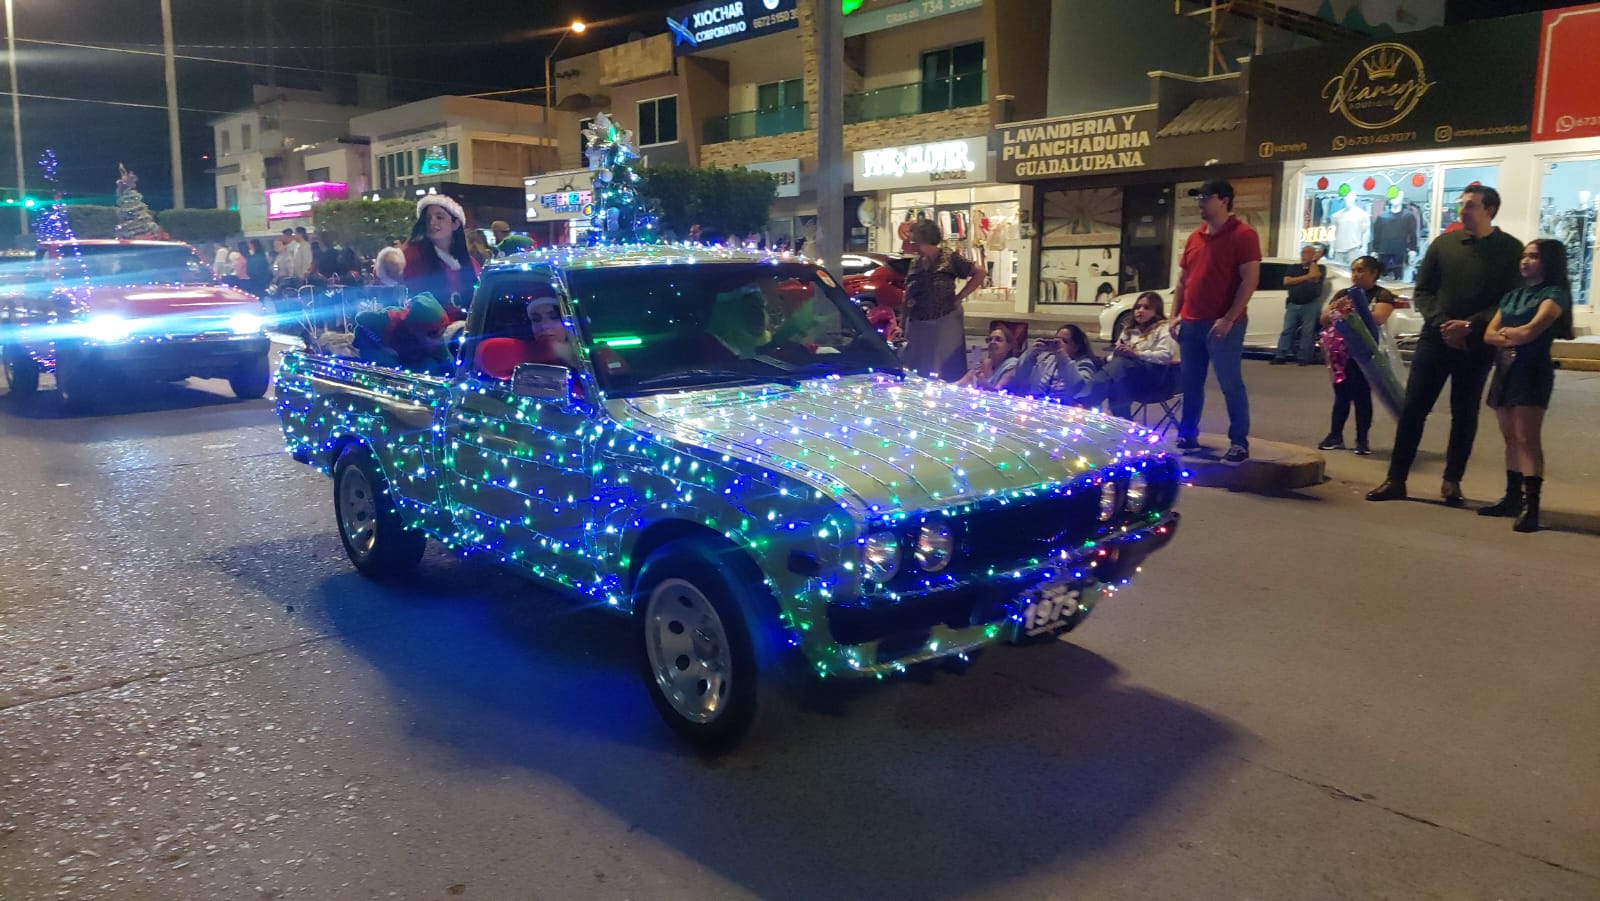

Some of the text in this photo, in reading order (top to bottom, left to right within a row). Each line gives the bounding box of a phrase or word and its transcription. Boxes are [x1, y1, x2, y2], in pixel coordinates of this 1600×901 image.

[693, 1, 744, 28] XIOCHAR
[695, 21, 747, 43] CORPORATIVO
[1004, 114, 1136, 145] LAVANDERIA Y
[1002, 130, 1151, 161] PLANCHADURIA
[1015, 150, 1144, 177] GUADALUPANA
[1024, 590, 1080, 629] 1975
